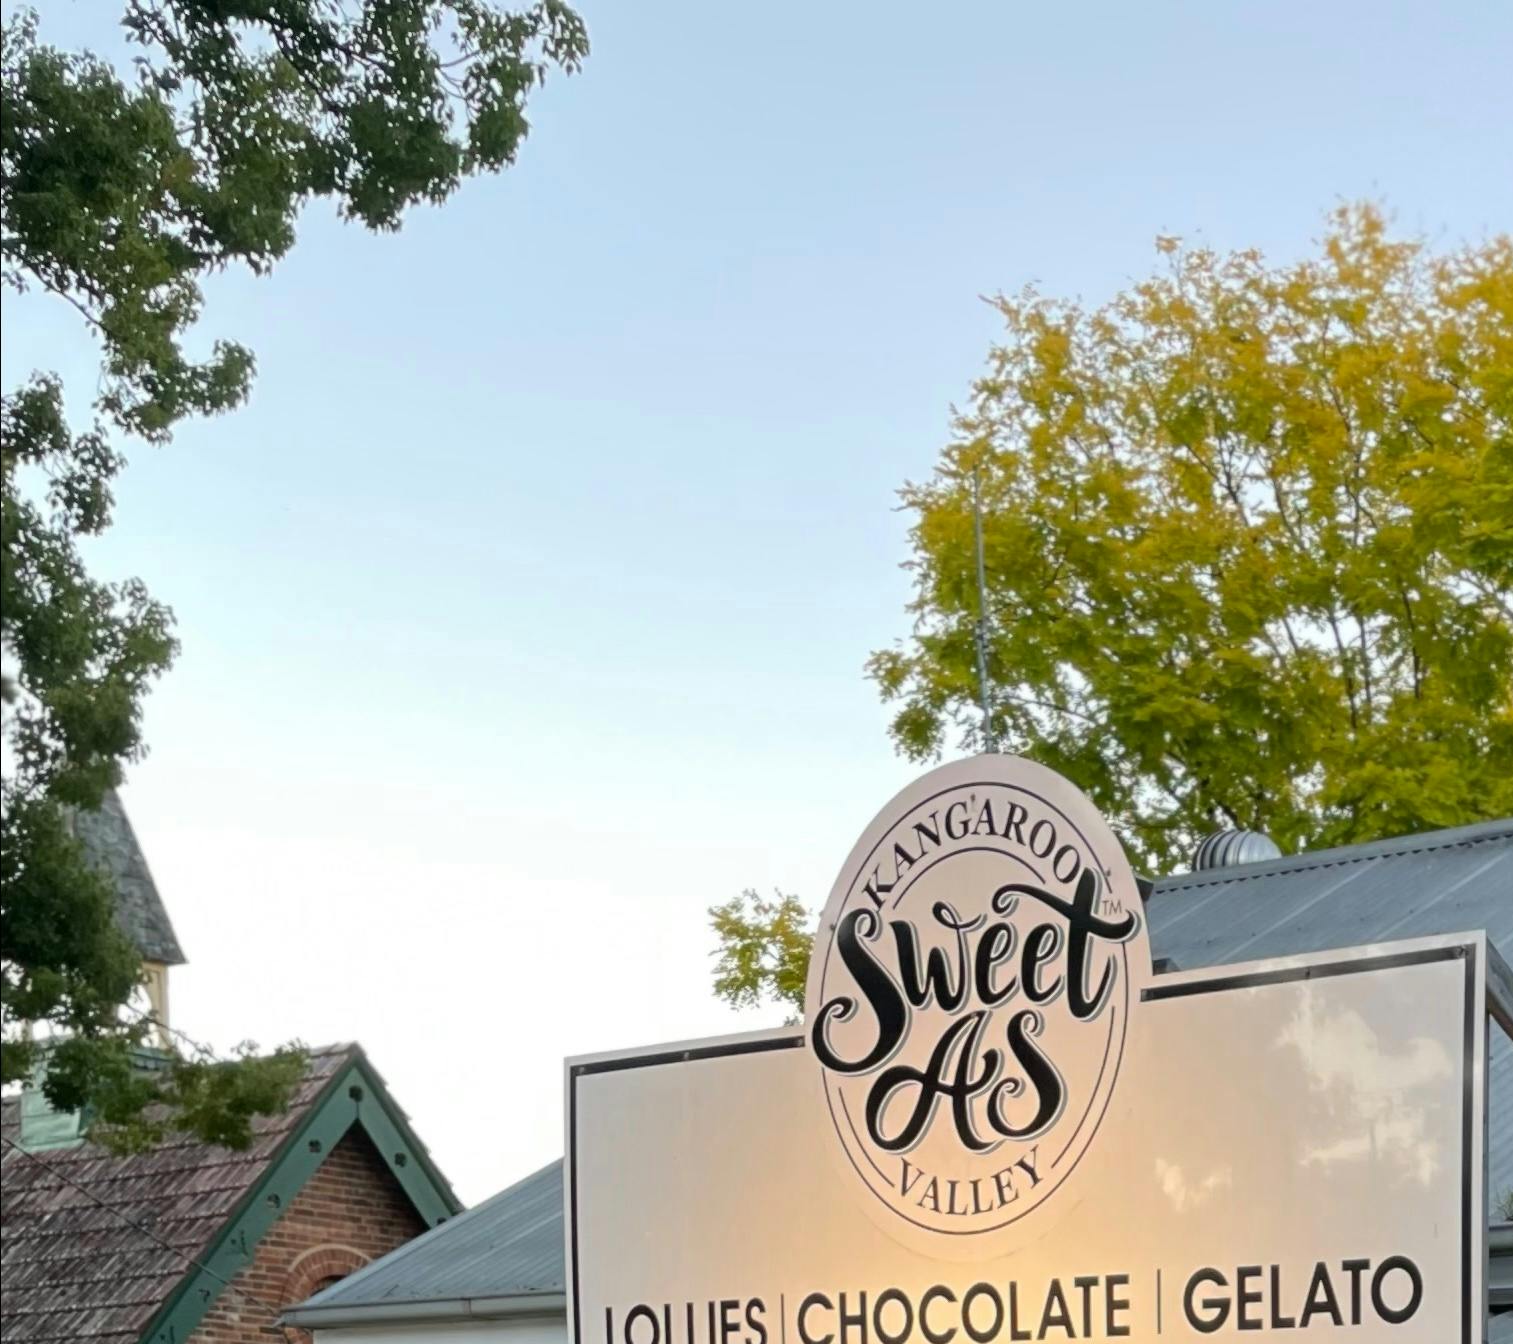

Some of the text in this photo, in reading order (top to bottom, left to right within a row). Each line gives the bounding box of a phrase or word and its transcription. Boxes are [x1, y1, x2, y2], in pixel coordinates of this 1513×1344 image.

[862, 798, 1081, 912] KANGAROO
[812, 867, 1139, 1075] Sweet
[901, 1145, 1043, 1216] VALLEY
[1183, 1254, 1424, 1334] GELATO
